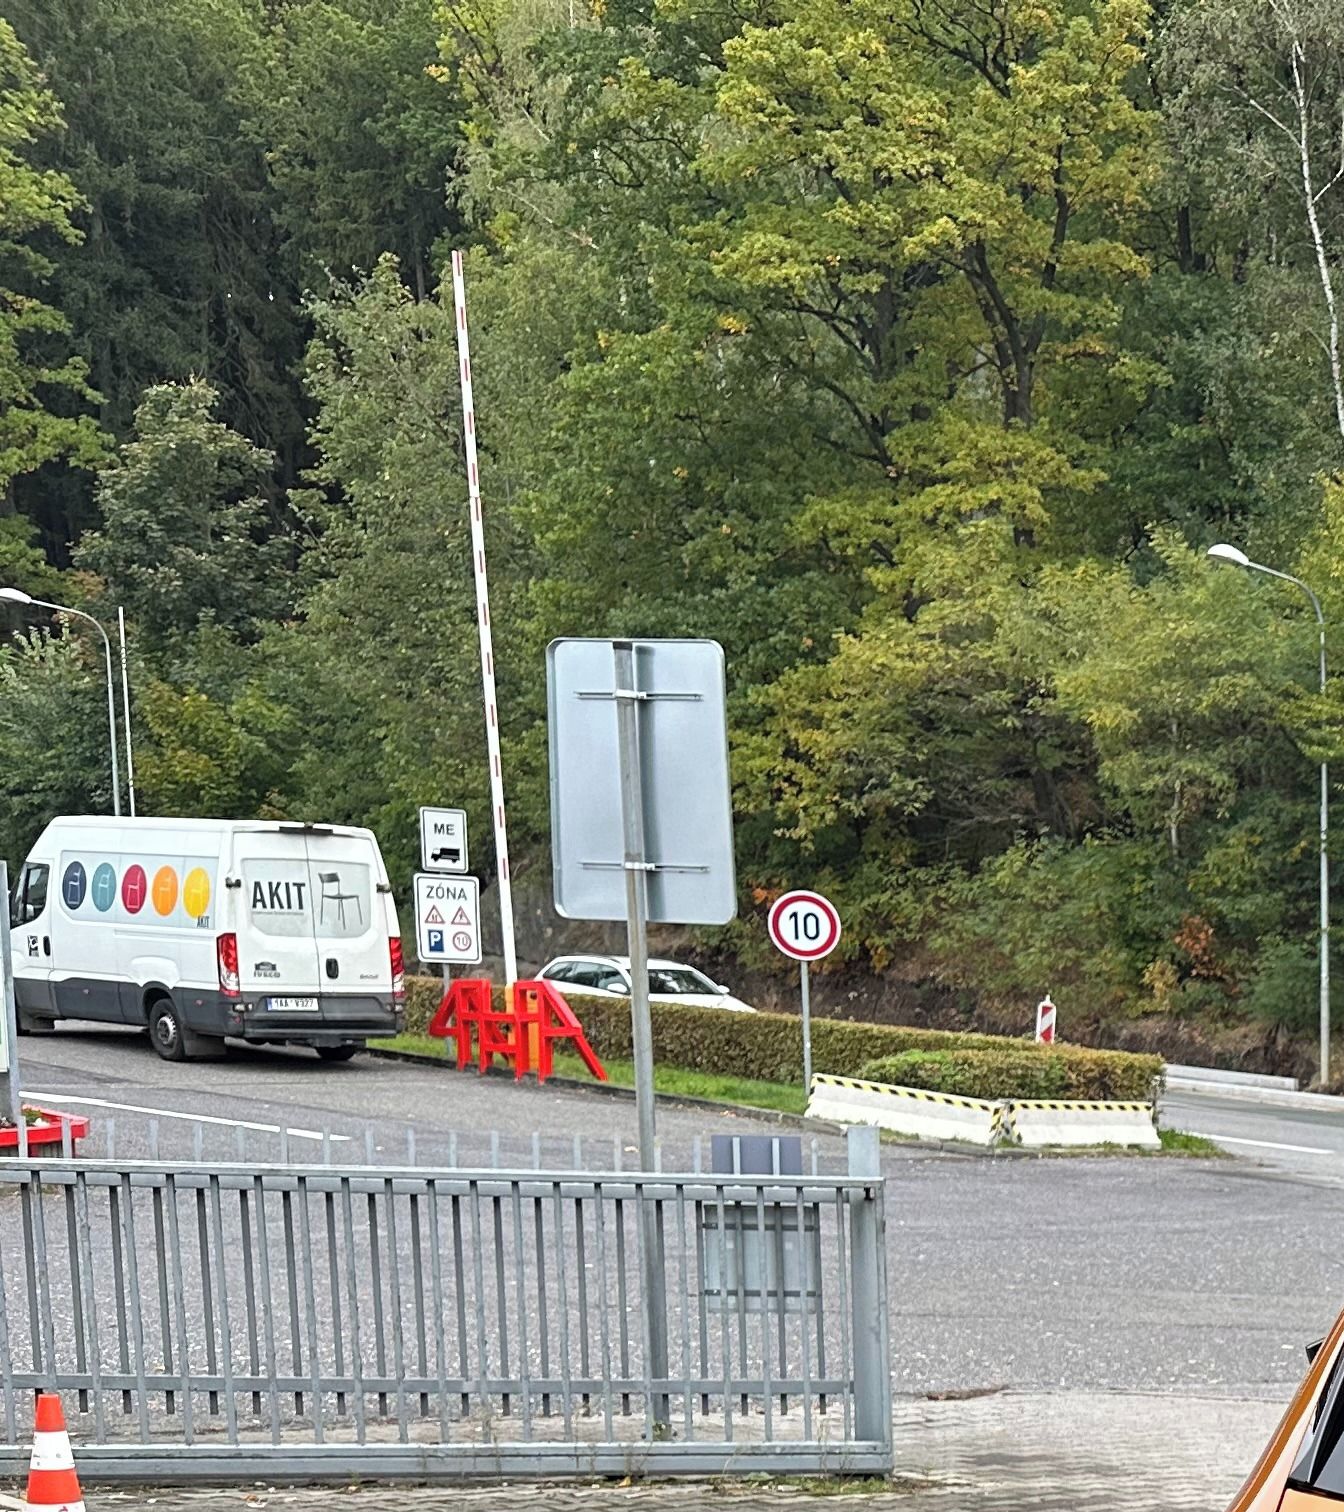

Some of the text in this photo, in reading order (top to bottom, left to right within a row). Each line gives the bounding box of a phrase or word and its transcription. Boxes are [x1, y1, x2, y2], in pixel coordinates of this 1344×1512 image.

[434, 823, 455, 835] ME
[252, 881, 306, 910] AKIT
[426, 883, 467, 901] ZÓNA
[789, 911, 820, 940] 10
[430, 932, 441, 946] P
